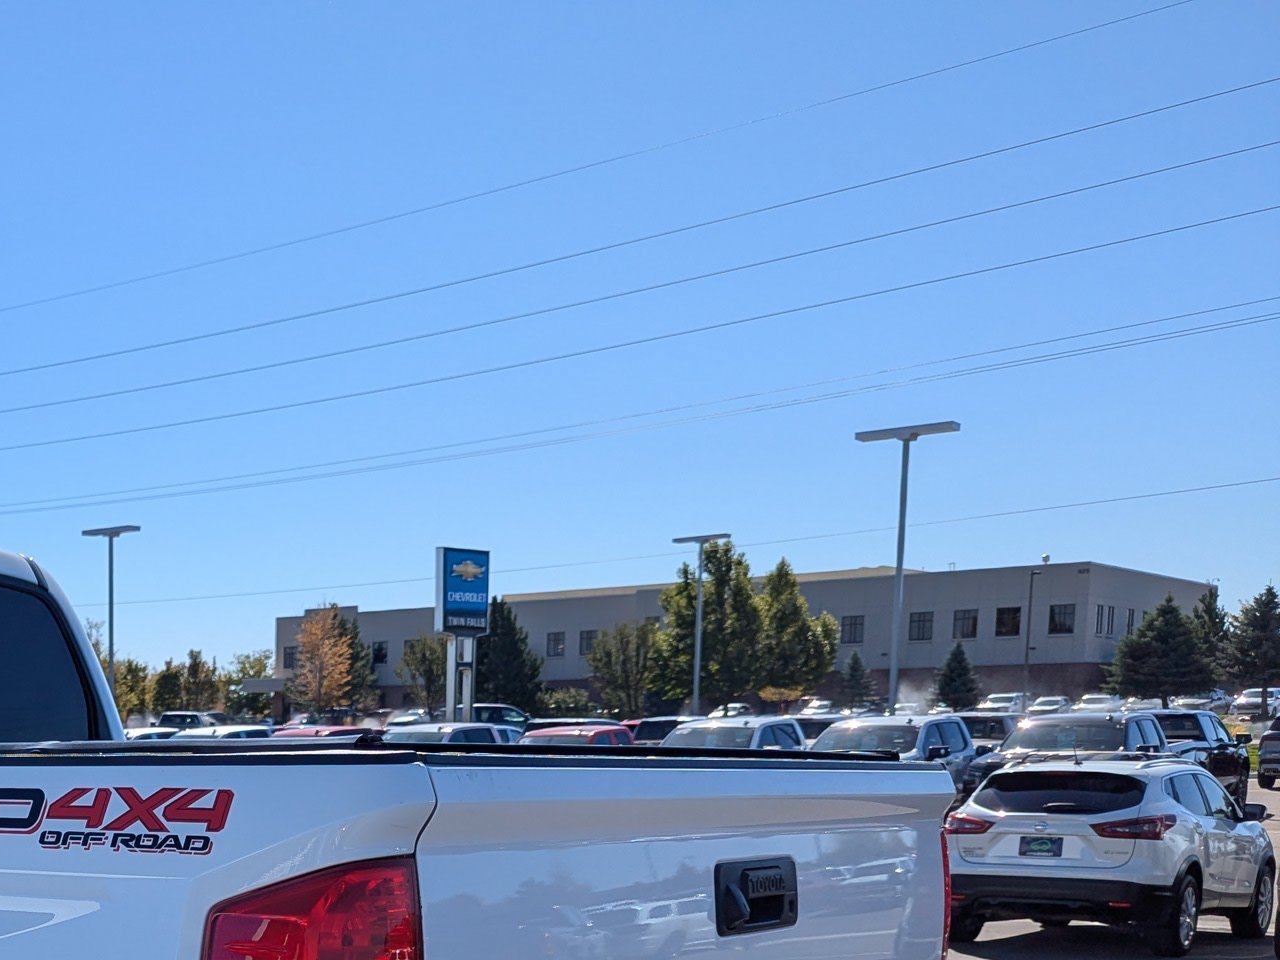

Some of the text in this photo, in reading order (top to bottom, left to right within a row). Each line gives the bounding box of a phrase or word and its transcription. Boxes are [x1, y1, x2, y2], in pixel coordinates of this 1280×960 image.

[448, 592, 486, 602] CHEVROLET
[448, 616, 486, 627] TWIN FALLS
[46, 787, 235, 832] 4X4
[39, 830, 213, 855] OFF ROAD
